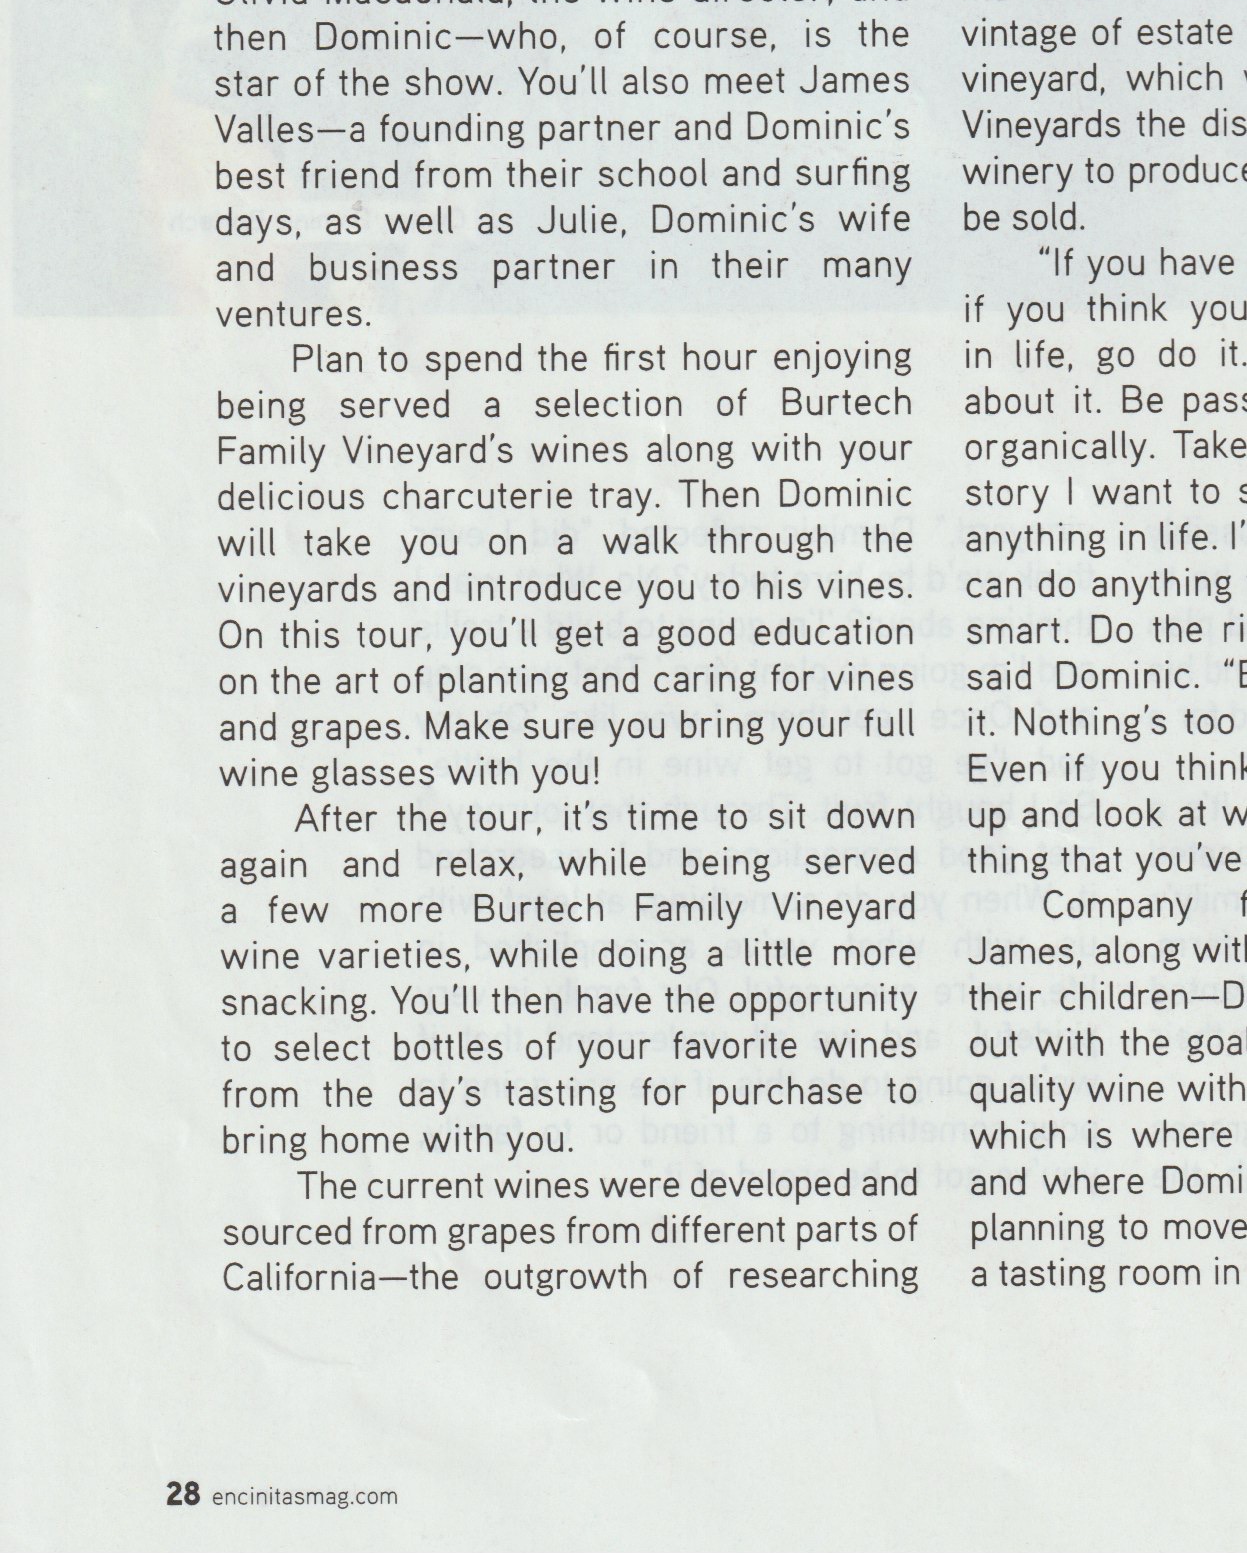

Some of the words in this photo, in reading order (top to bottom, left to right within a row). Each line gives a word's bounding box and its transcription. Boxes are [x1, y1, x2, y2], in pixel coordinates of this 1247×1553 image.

[961, 17, 1077, 54] vintage
[1091, 16, 1123, 46] of
[1137, 18, 1233, 46] estate
[961, 108, 1121, 147] Vineyards
[1136, 108, 1186, 138] the
[216, 160, 285, 190] best
[301, 159, 399, 189] friend
[414, 159, 492, 189] from
[506, 158, 583, 188] their
[598, 157, 708, 188] school
[722, 157, 781, 187] and
[796, 156, 911, 193] surfing
[216, 252, 274, 282] and
[310, 251, 458, 282] business
[493, 253, 616, 289] partner
[651, 258, 678, 280] in
[711, 249, 789, 279] their
[823, 256, 912, 286] many
[965, 293, 985, 323] if
[1006, 301, 1064, 331] you
[1086, 292, 1167, 322] think
[1190, 300, 1247, 330] you
[217, 390, 306, 427] being
[340, 388, 450, 419] served
[484, 396, 500, 418] a
[535, 388, 682, 418] selection
[716, 387, 748, 417] of
[782, 386, 912, 416] Burtech
[217, 573, 377, 611] vineyards
[393, 572, 450, 602] and
[467, 572, 622, 602] introduce
[637, 579, 695, 610] you
[710, 573, 740, 600] to
[756, 570, 803, 600] his
[817, 569, 913, 599] vines.
[1043, 889, 1193, 927] Company
[220, 948, 299, 970] wine
[318, 939, 470, 972] varieties,
[489, 938, 578, 968] while
[598, 938, 687, 975] doing
[707, 946, 723, 968] a
[744, 937, 813, 967] little
[833, 944, 916, 966] more
[969, 1030, 1018, 1058] out
[1035, 1027, 1104, 1057] with
[1120, 1026, 1170, 1057] the
[969, 1119, 1066, 1150] which
[1087, 1119, 1113, 1149] is
[1131, 1119, 1233, 1149] where
[296, 1170, 357, 1200] The
[367, 1172, 484, 1200] current
[494, 1169, 589, 1199] wines
[599, 1177, 680, 1198] were
[690, 1167, 851, 1206] developed
[862, 1167, 918, 1197] and
[971, 1266, 987, 1287] a
[998, 1257, 1106, 1294] tasting
[1119, 1264, 1201, 1286] room
[1215, 1264, 1240, 1285] in
[166, 1480, 201, 1506] 28
[212, 1486, 398, 1510] encinitasmag.com
